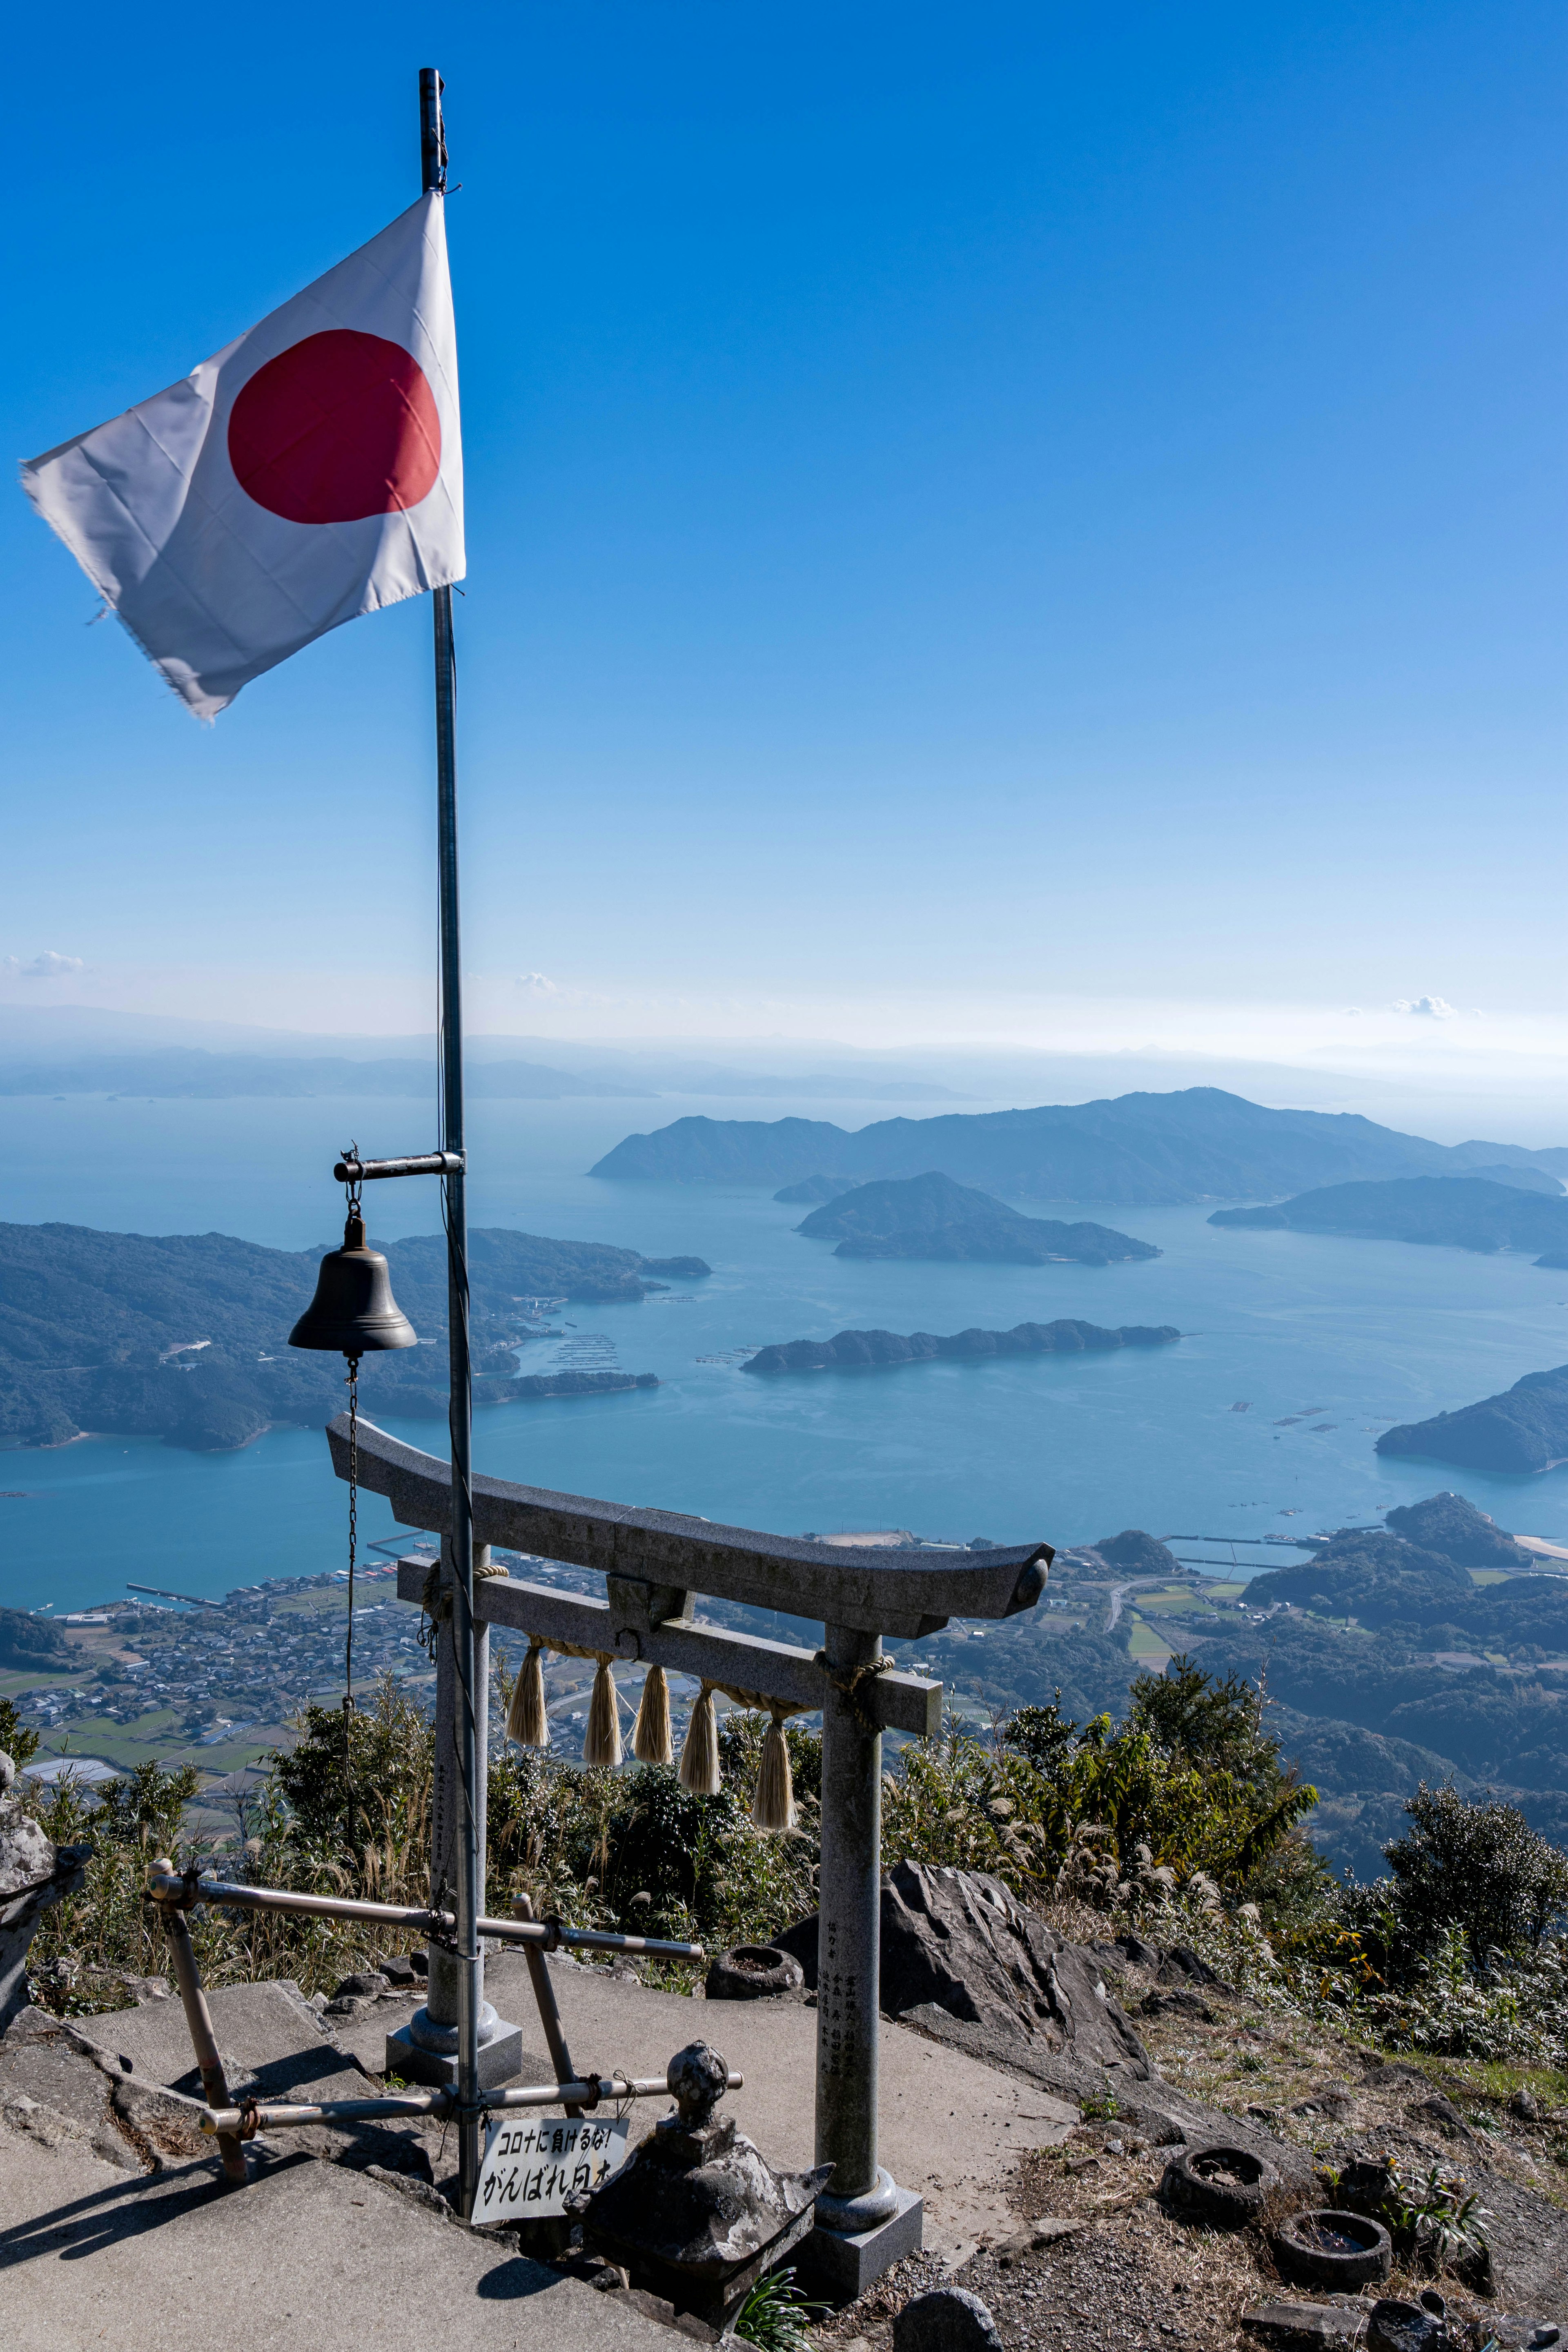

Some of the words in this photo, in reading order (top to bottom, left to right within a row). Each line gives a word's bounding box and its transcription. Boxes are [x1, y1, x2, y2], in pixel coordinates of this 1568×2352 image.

[437, 1764, 445, 1861] 平成二十八年四月吉日
[827, 1921, 836, 1960] 協力者
